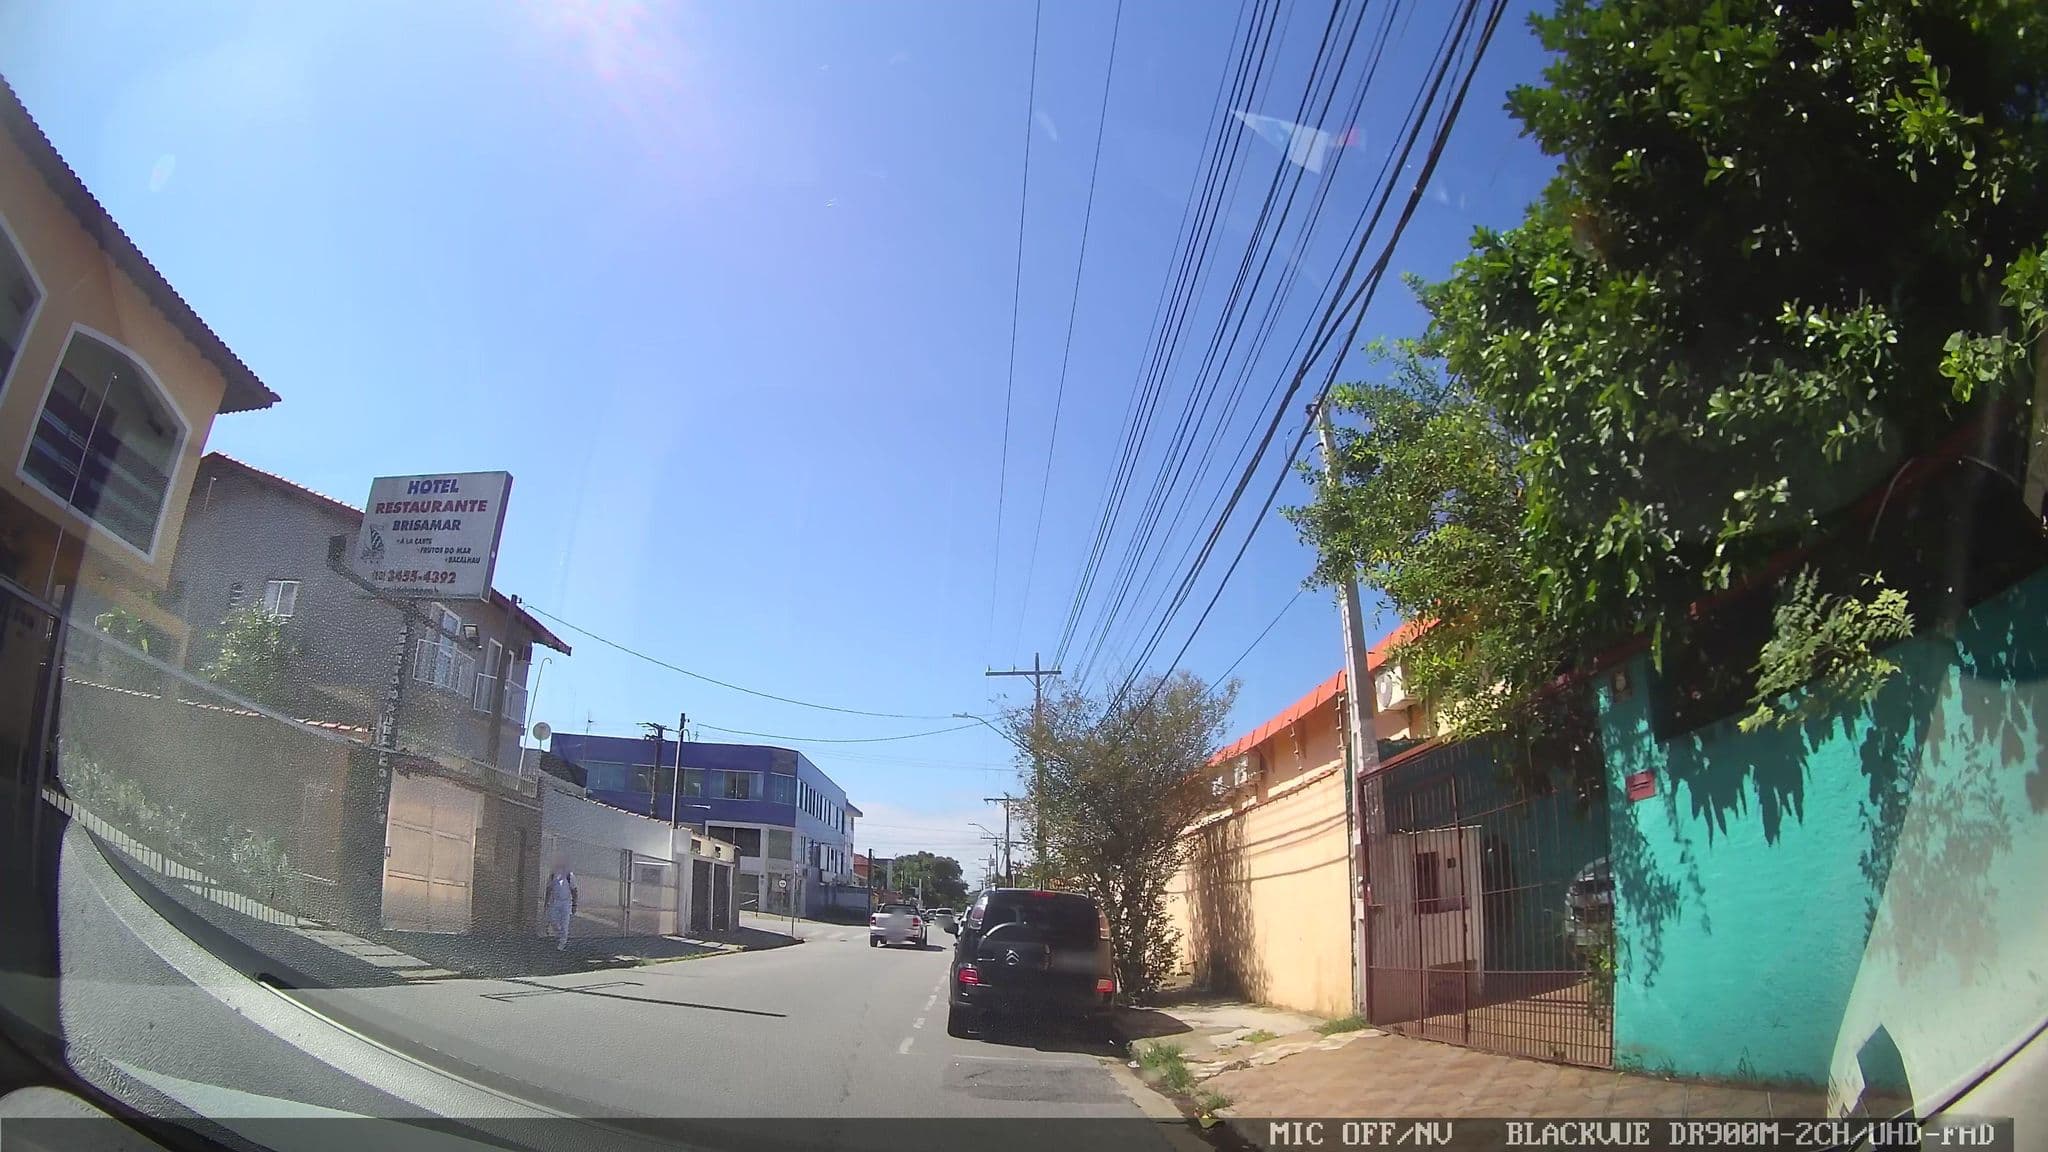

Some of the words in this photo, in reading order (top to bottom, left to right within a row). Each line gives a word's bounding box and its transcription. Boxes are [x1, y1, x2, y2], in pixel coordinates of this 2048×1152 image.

[407, 479, 460, 495] HOTEL
[375, 499, 488, 514] RESTAURANTE
[392, 519, 461, 531] BRISAMAR
[420, 546, 443, 554] FRUTOS
[444, 546, 454, 554] DO
